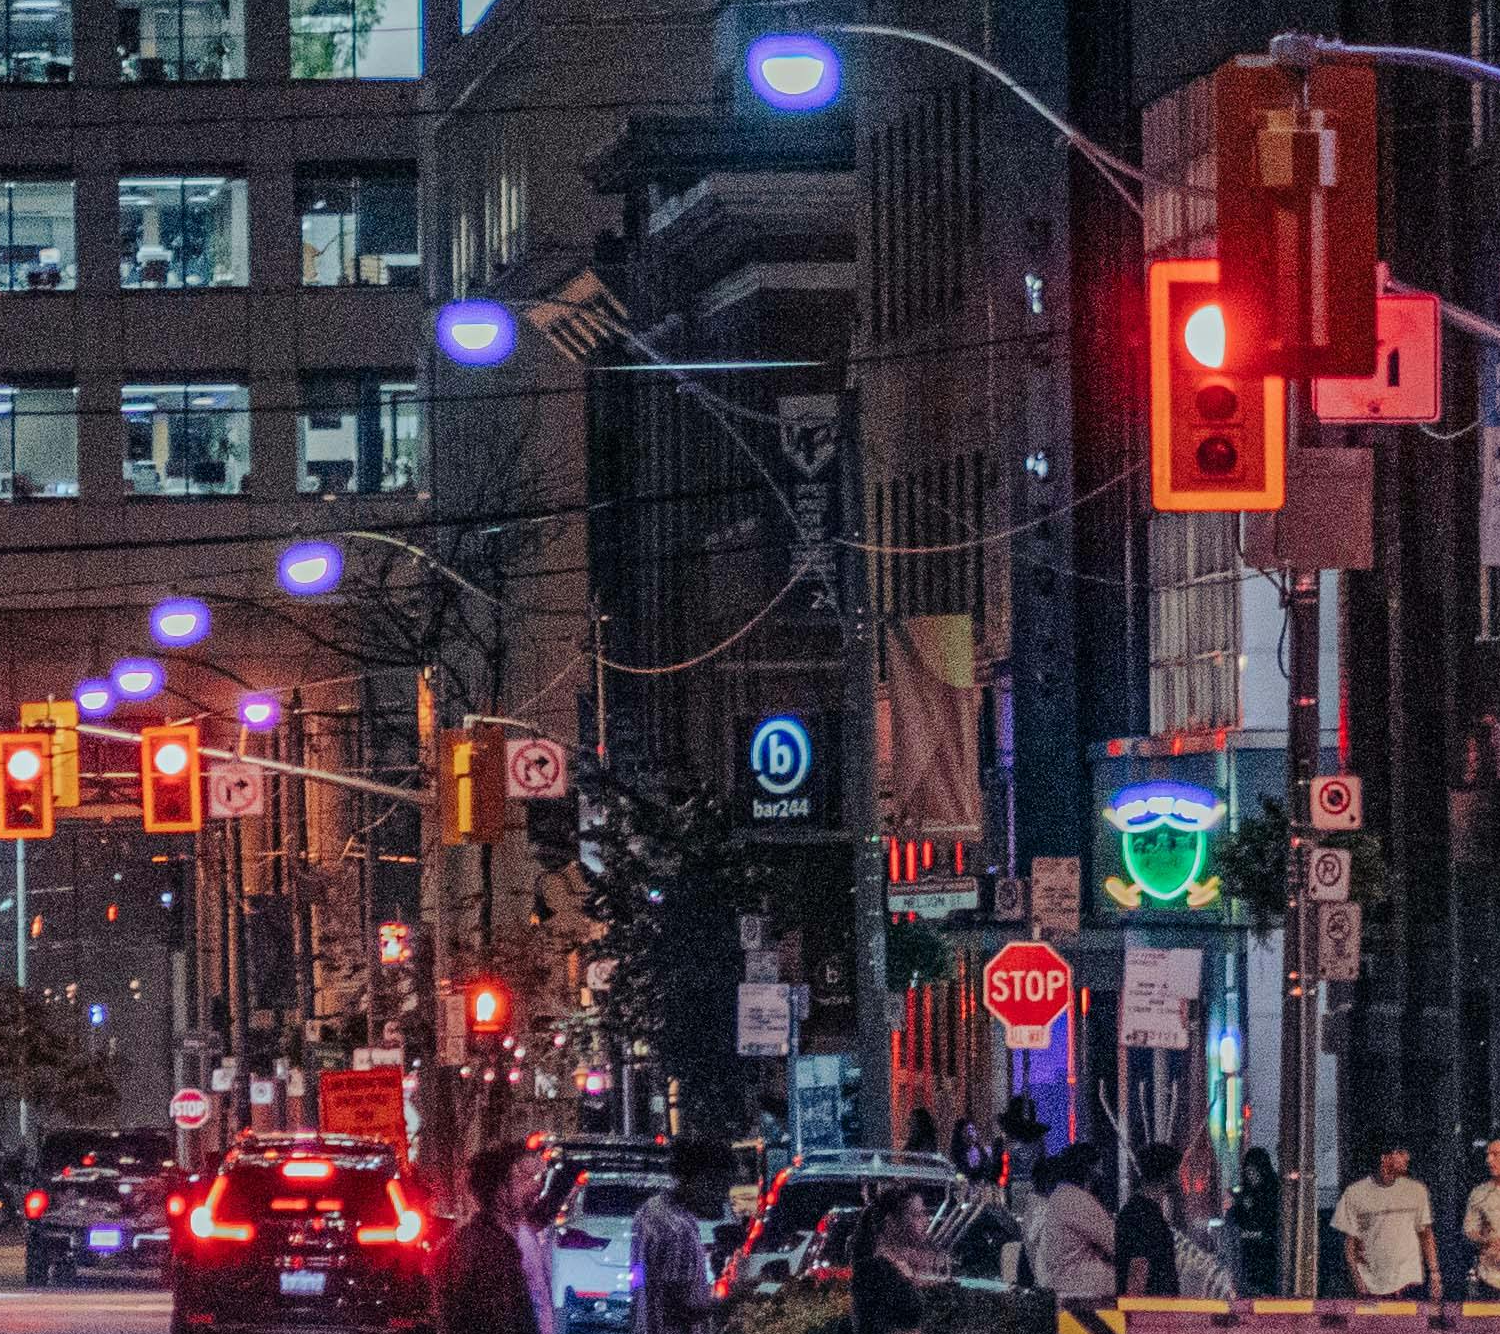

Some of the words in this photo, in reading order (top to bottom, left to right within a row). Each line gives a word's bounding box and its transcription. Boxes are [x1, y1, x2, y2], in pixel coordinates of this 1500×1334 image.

[752, 798, 810, 819] bar244
[991, 969, 1067, 1004] STOP
[173, 1100, 206, 1117] STOP
